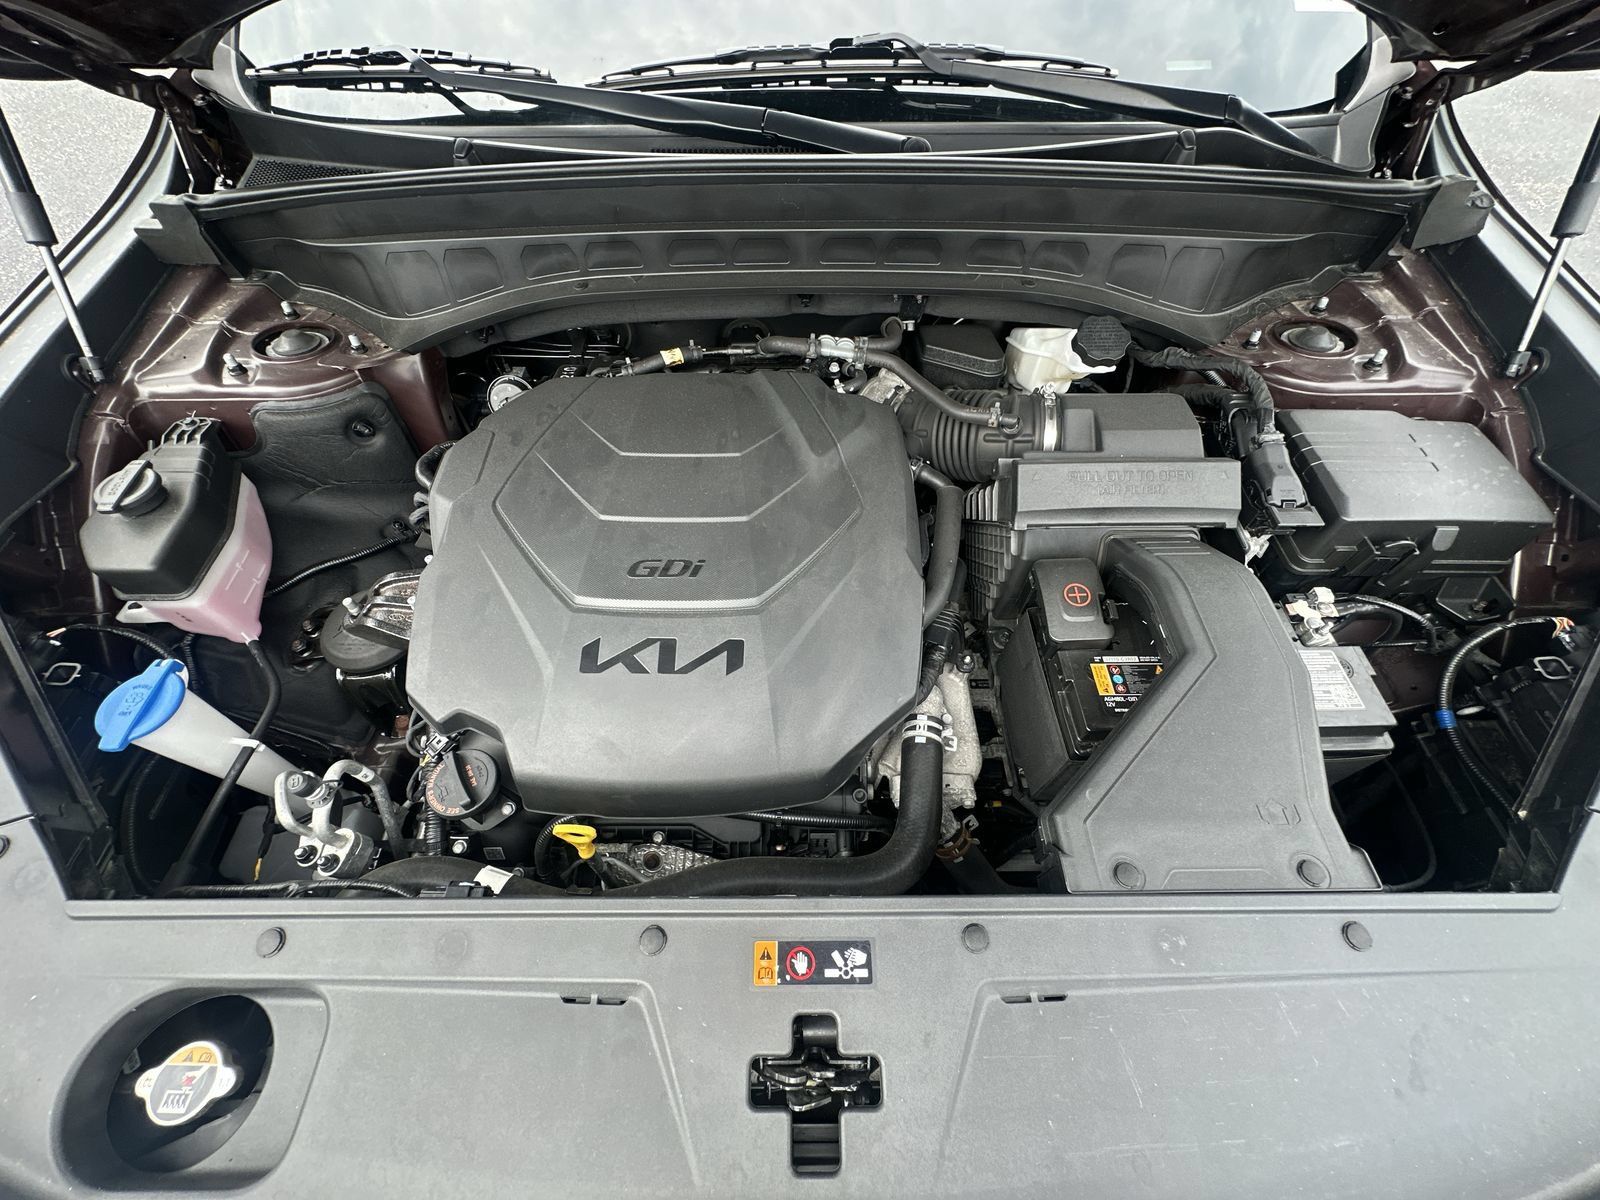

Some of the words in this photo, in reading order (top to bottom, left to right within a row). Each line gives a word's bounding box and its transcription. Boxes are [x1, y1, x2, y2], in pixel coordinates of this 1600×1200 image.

[1068, 470, 1102, 482] PULL
[1106, 470, 1133, 481] OUT
[1137, 470, 1154, 481] TO
[1159, 469, 1194, 481] OPEN
[627, 559, 706, 578] GDi
[579, 636, 745, 676] KIA
[427, 762, 445, 788] MANUAL
[427, 790, 446, 812] OWNER'S
